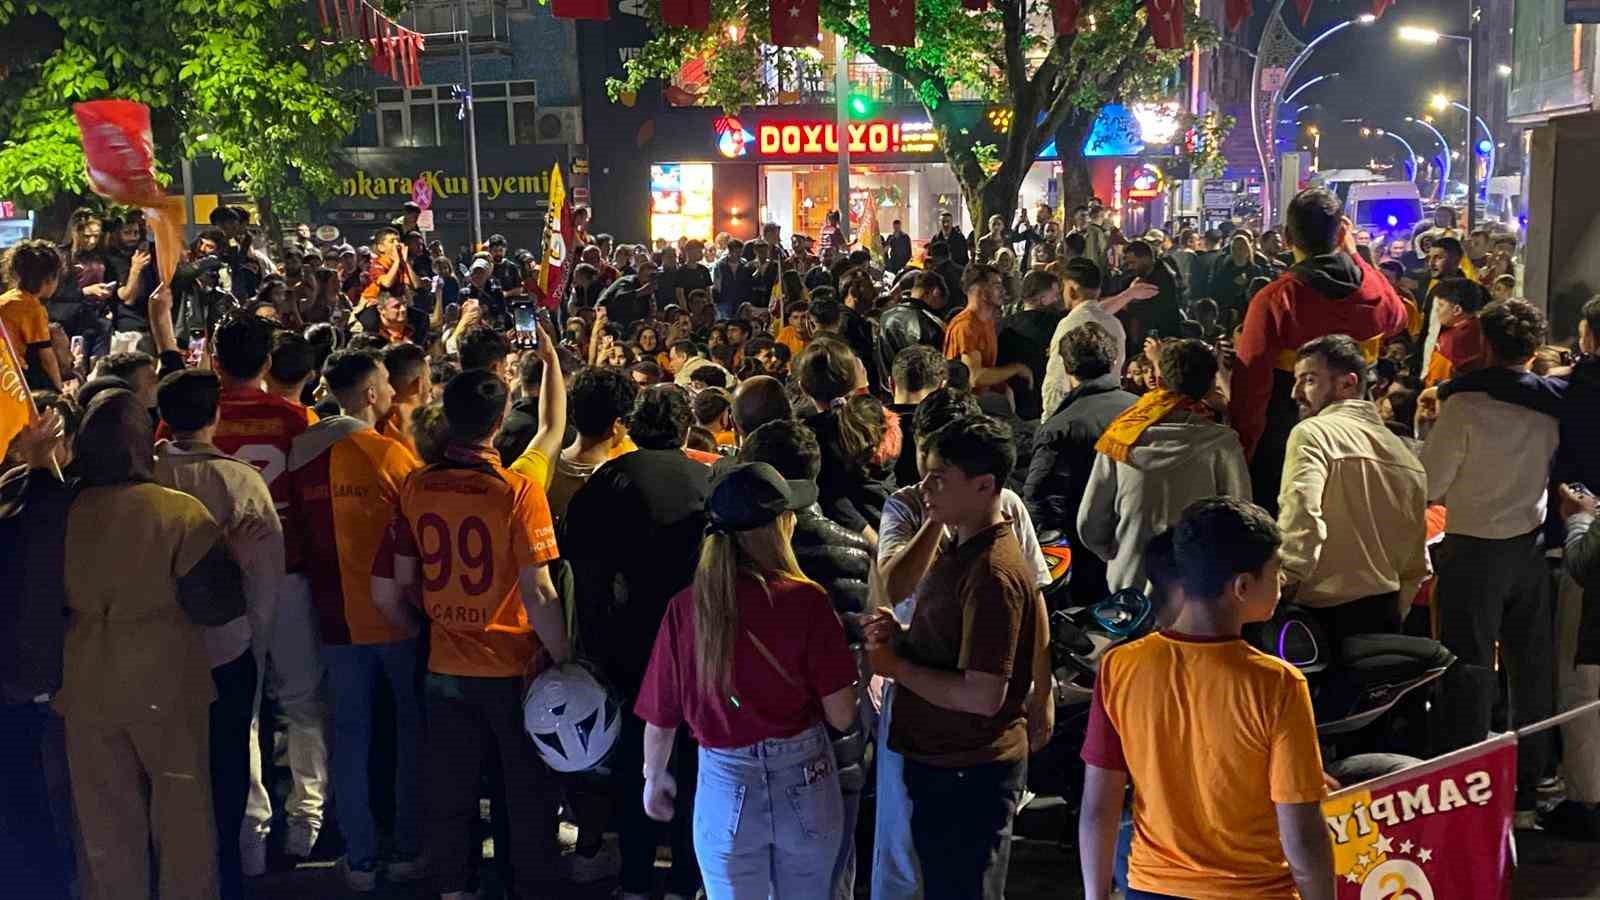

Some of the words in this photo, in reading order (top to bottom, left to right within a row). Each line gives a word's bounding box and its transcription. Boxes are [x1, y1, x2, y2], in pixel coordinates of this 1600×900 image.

[760, 123, 900, 153] DOYUYO!
[336, 170, 412, 199] nkara
[420, 169, 549, 199] Kuruyemi
[417, 512, 494, 596] 99
